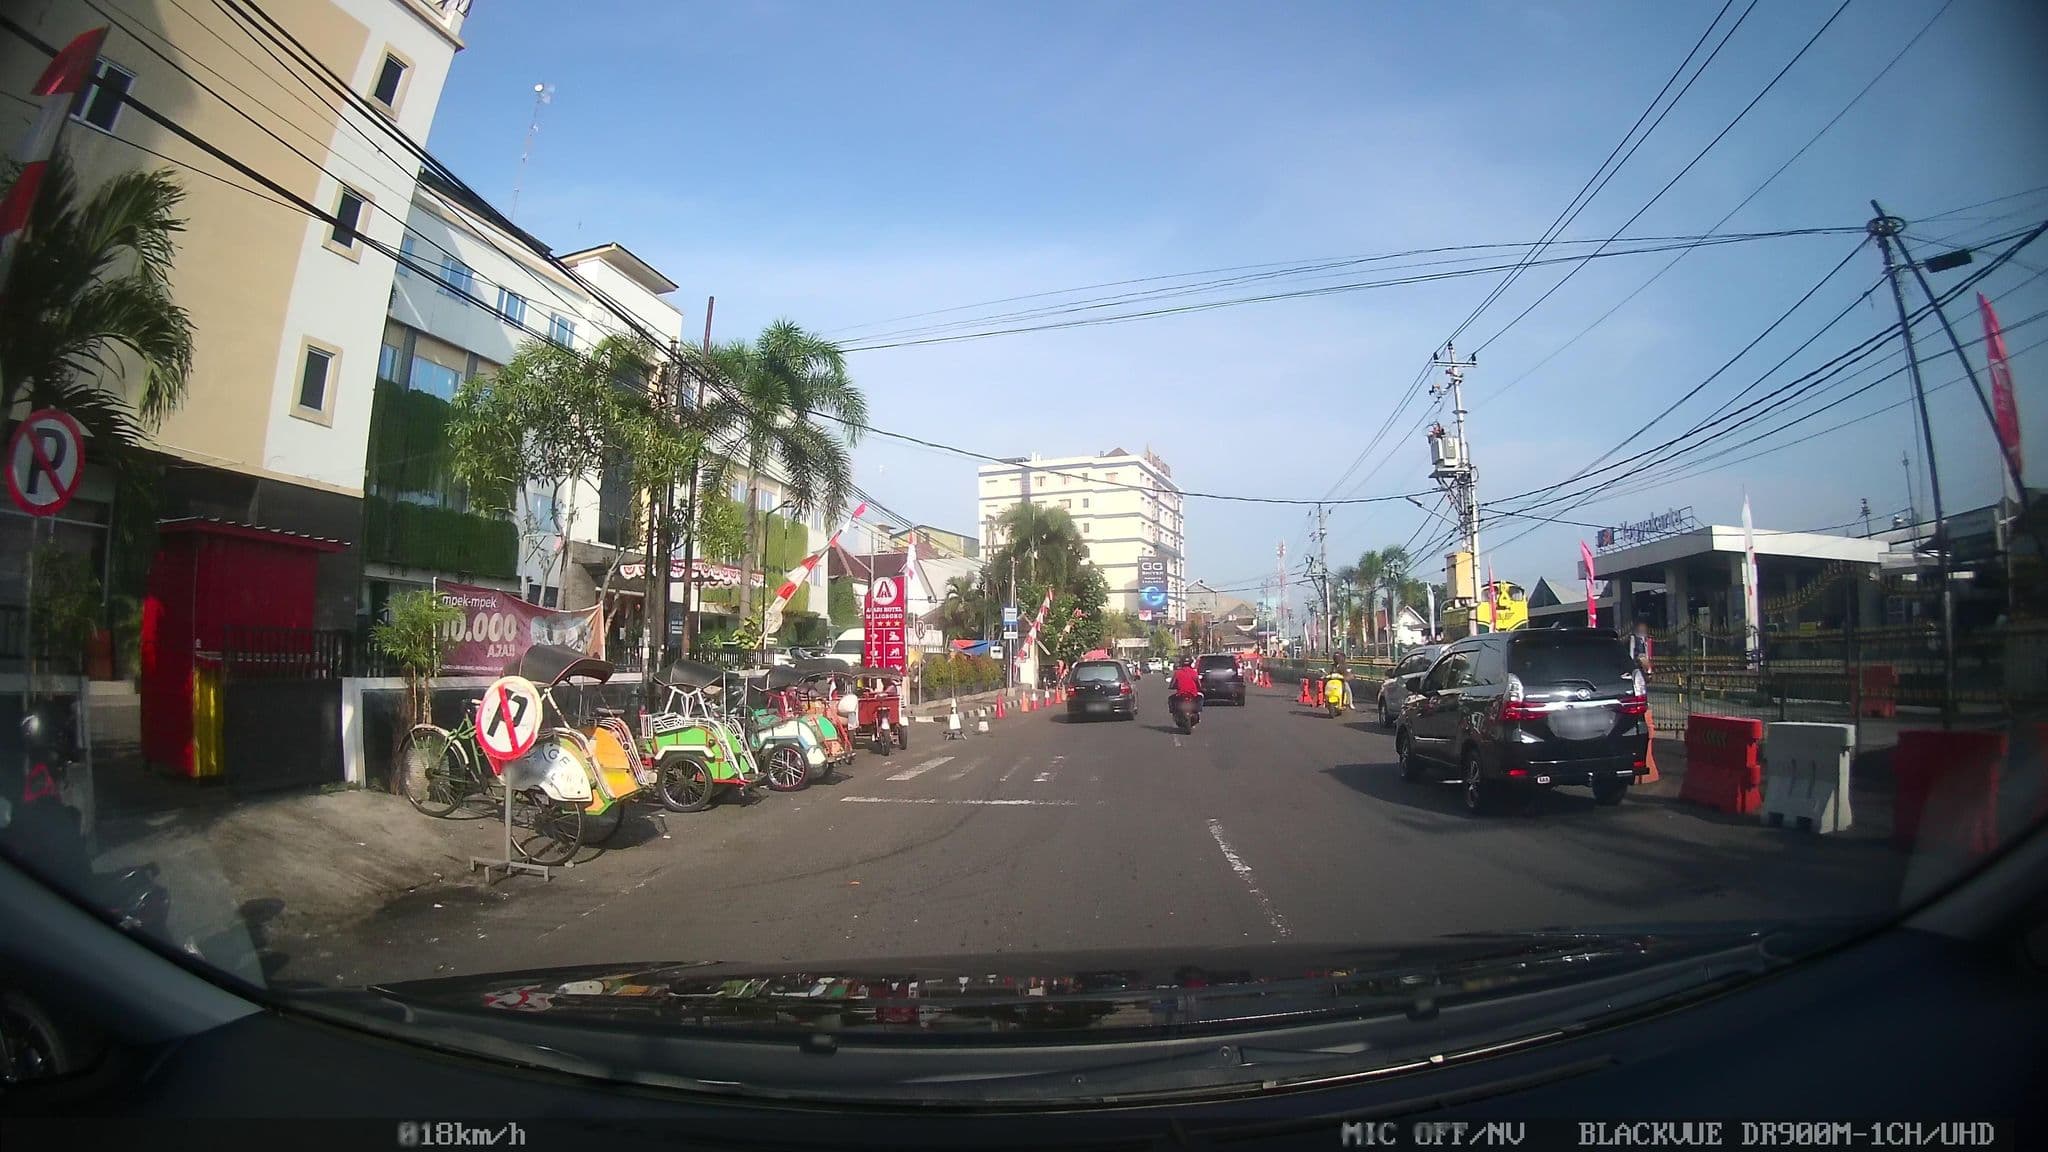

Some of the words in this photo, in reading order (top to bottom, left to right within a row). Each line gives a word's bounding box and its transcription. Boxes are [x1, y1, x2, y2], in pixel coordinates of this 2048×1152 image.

[26, 427, 67, 494] P
[1620, 507, 1680, 542] Yogyakarta
[442, 594, 497, 610] mpek-mpek
[487, 688, 528, 737] P
